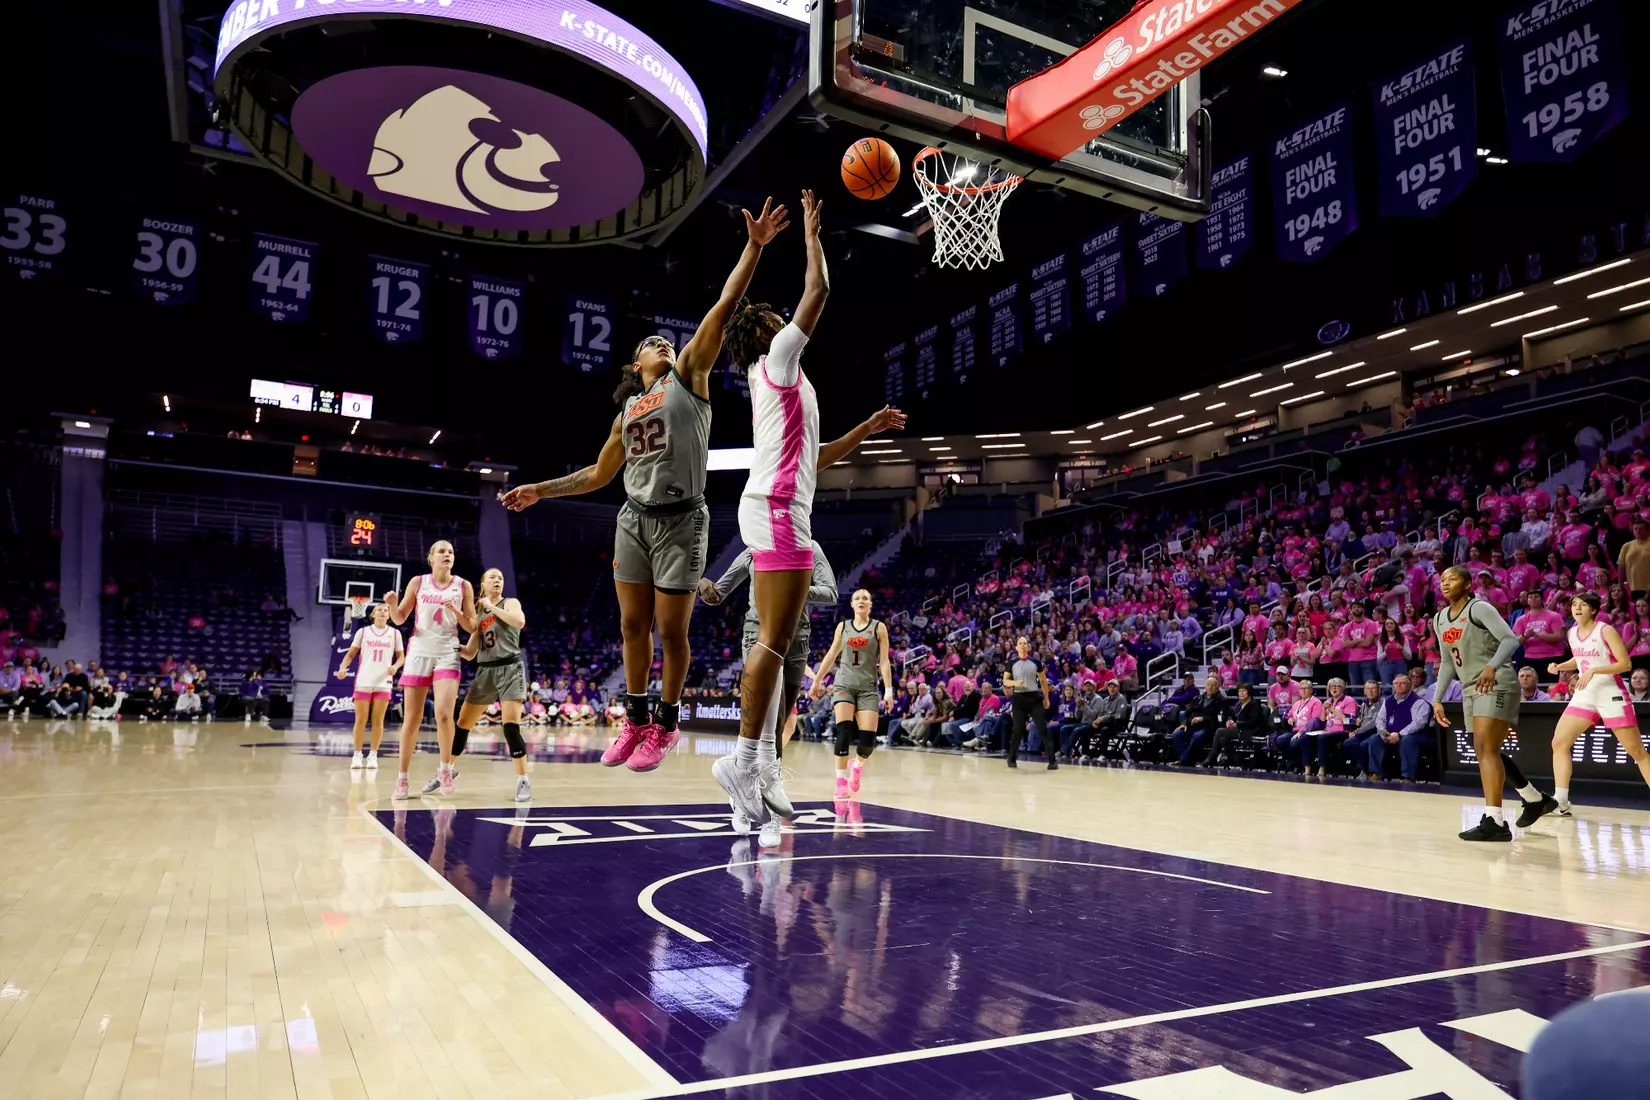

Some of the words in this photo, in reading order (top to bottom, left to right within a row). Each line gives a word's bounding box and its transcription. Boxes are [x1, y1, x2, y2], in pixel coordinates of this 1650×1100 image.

[1506, 0, 1576, 36] K-ST
[1544, 0, 1592, 26] BASKETB
[216, 0, 279, 62] MBER
[1522, 23, 1600, 74] FINAL
[1380, 44, 1464, 102] K-STATE
[1410, 65, 1459, 94] BASKETBALL
[1524, 44, 1600, 95] FOUR
[1393, 93, 1456, 136] FINAL
[1522, 81, 1610, 138] 1958
[1275, 107, 1346, 155] K-STATE
[1394, 112, 1455, 155] FOUR
[1211, 157, 1249, 185] STATE
[1285, 151, 1337, 188] FINAL
[1396, 145, 1463, 195] 1951
[1286, 168, 1336, 205] FOUR
[20, 195, 55, 210] PARR
[1210, 200, 1223, 213] ITE
[1223, 188, 1248, 208] EIGHT
[1228, 203, 1244, 215] 1964
[0, 207, 67, 256] 33
[142, 218, 194, 236] BOOZER
[1206, 214, 1221, 226] 1951
[1207, 223, 1222, 235] 1958
[1229, 213, 1244, 225] 1972
[1229, 222, 1245, 234] 1973
[1284, 200, 1343, 241] 1948
[1082, 226, 1120, 253] K-STATE
[1138, 232, 1157, 248] SWEET
[1158, 221, 1183, 239] SIXTEEN
[1207, 232, 1222, 244] 1959
[1208, 241, 1222, 253] 1961
[1229, 231, 1246, 243] 1975
[132, 231, 198, 279] 30
[257, 239, 312, 258] MURRELL
[251, 254, 312, 300] 44
[376, 262, 420, 279] KRUGER
[1032, 254, 1065, 280] K-STATE
[371, 276, 421, 320] 12
[472, 280, 521, 297] WILLIAMS
[472, 294, 519, 335] 10
[575, 300, 606, 313] EVANS
[376, 319, 412, 332] 1971-74
[568, 312, 611, 352] 12
[476, 336, 510, 348] 1972-76
[292, 394, 300, 404] 4
[352, 402, 360, 412] 0
[626, 417, 667, 456] 32
[351, 528, 372, 545] 24
[355, 519, 376, 531] 8:06
[432, 608, 443, 625] 4
[479, 631, 496, 652] 13
[372, 649, 384, 662] 11
[852, 650, 861, 666] 1
[1451, 647, 1463, 667] 3
[319, 695, 355, 712] Dill
